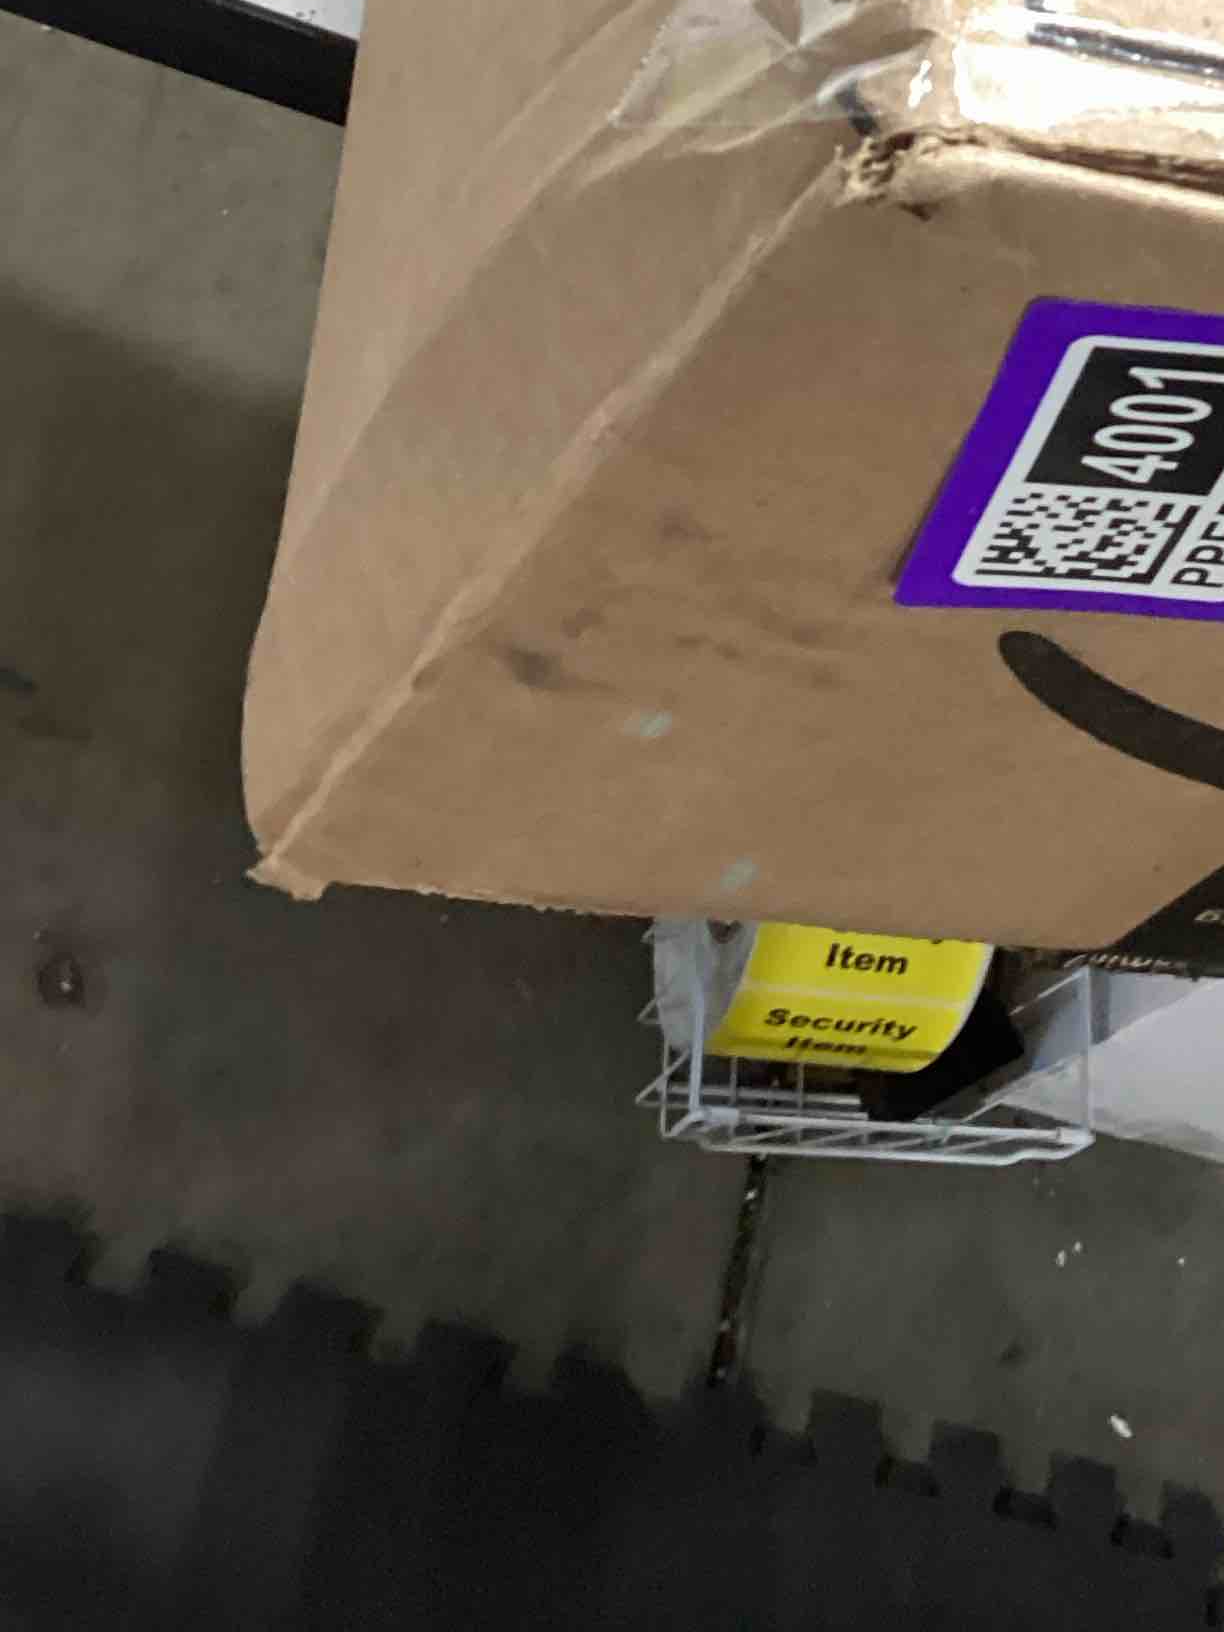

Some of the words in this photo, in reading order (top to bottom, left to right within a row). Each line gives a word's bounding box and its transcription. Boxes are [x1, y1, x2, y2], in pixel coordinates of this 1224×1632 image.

[826, 943, 909, 975] Item
[764, 1007, 918, 1042] Security
[784, 1035, 868, 1055] Item
